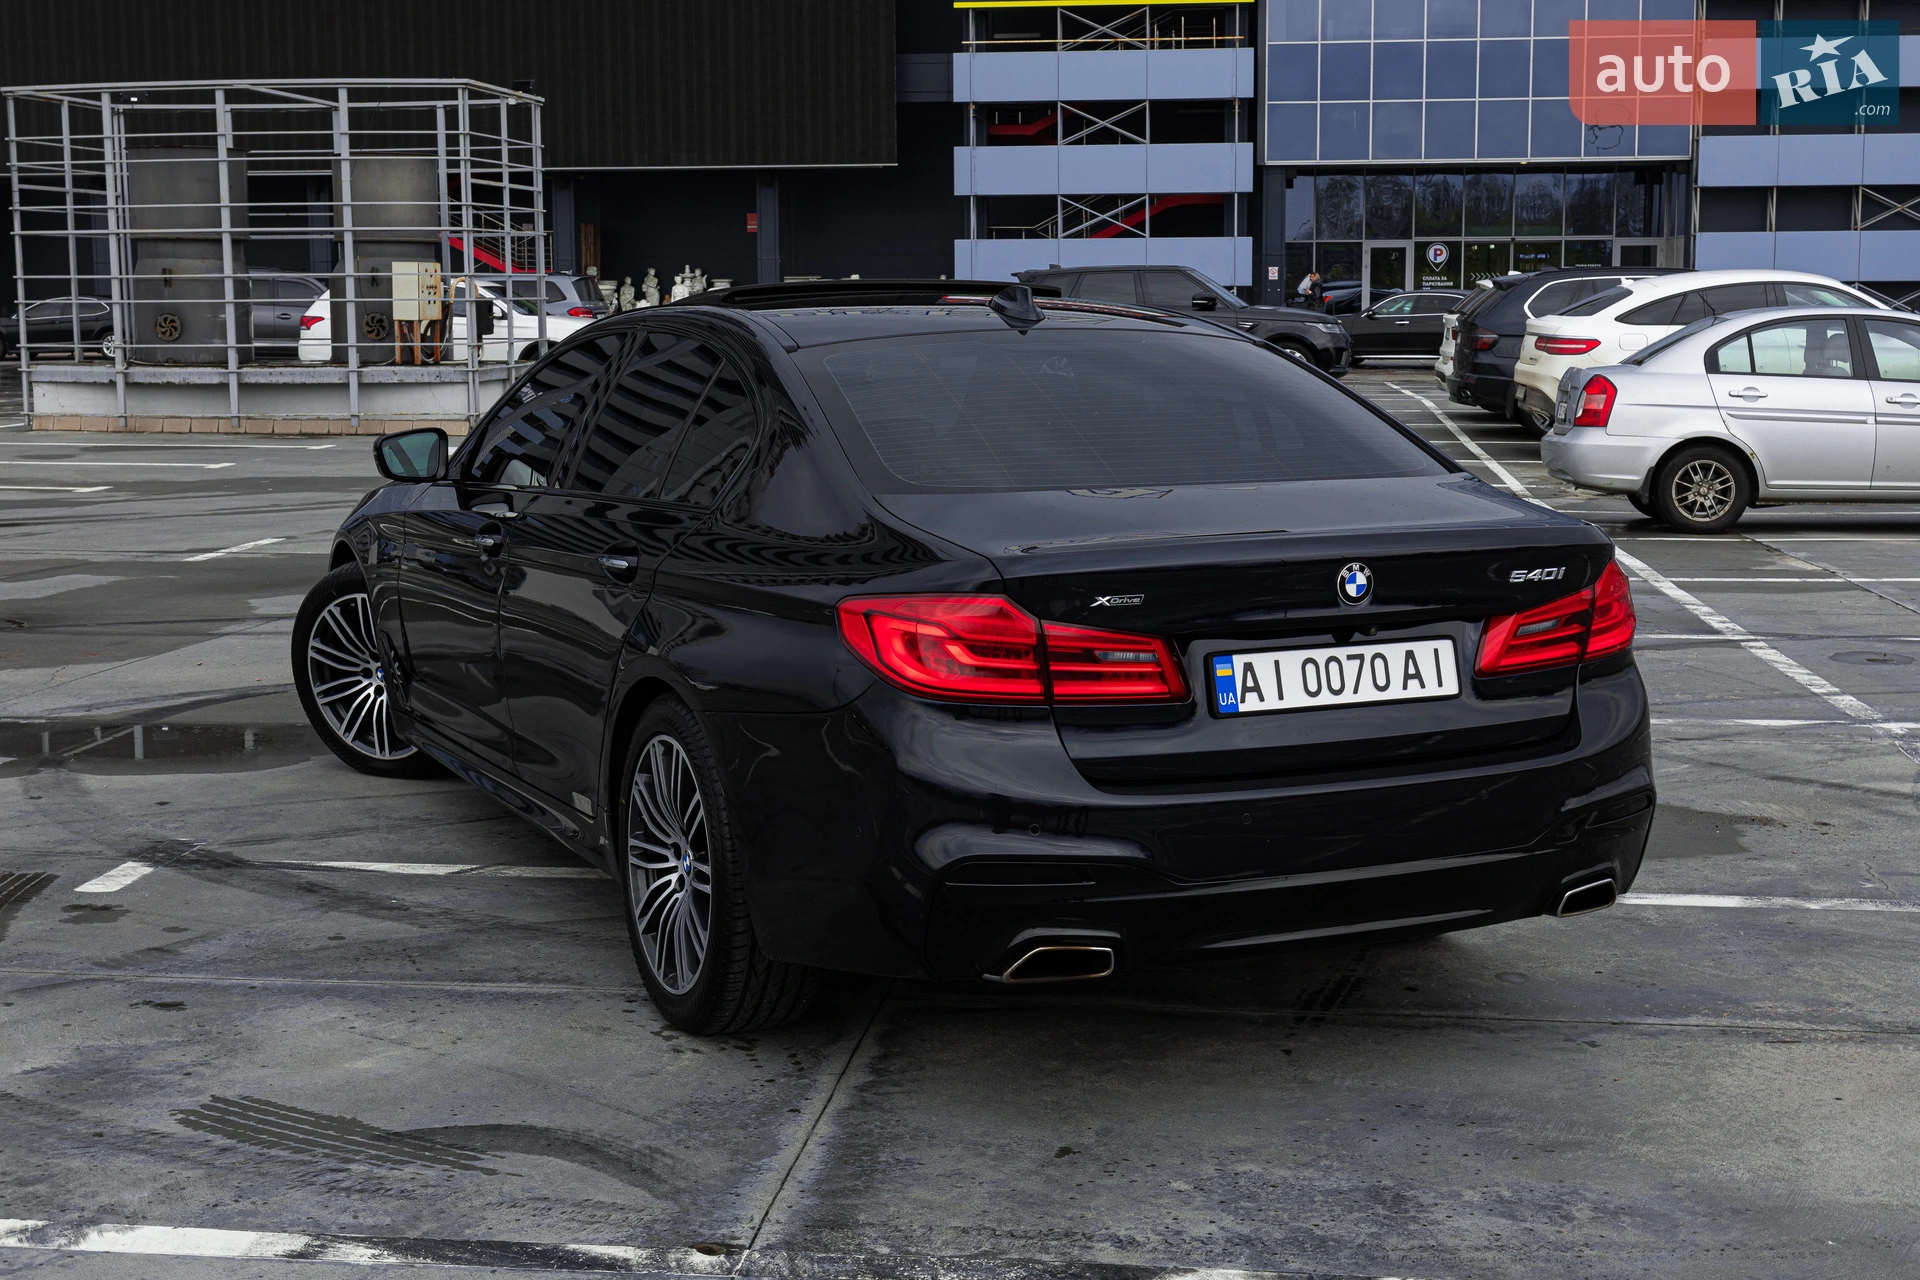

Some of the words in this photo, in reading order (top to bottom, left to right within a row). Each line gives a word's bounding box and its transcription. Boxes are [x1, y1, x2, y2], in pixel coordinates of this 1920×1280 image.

[1509, 566, 1566, 583] 540i
[1239, 659, 1284, 704] AI
[1301, 652, 1392, 698] 0070
[1402, 647, 1443, 690] AI
[1219, 692, 1236, 706] UA
